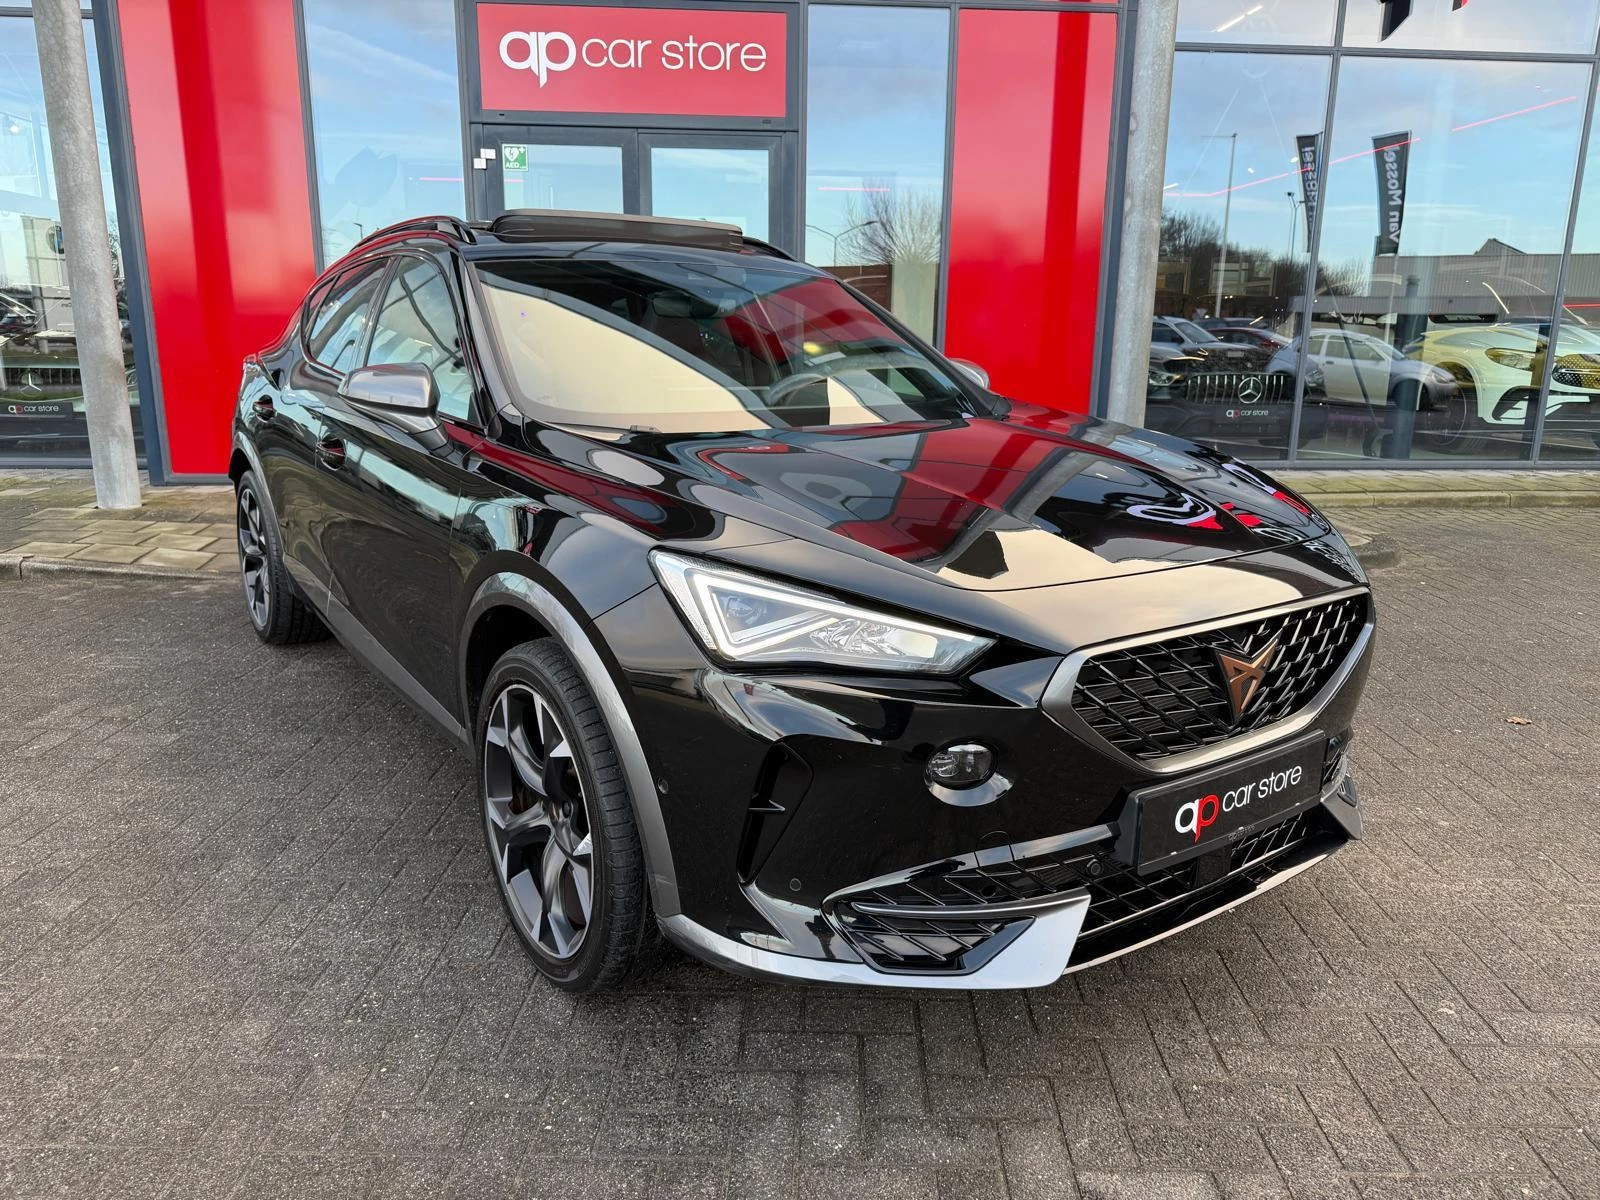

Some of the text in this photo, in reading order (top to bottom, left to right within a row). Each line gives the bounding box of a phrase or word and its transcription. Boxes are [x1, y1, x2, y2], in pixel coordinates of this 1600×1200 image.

[499, 31, 767, 88] ap car store
[505, 161, 520, 169] AED
[38, 404, 59, 412] store
[1174, 794, 1220, 843] ap
[1222, 782, 1257, 812] car
[1257, 765, 1303, 799] store
